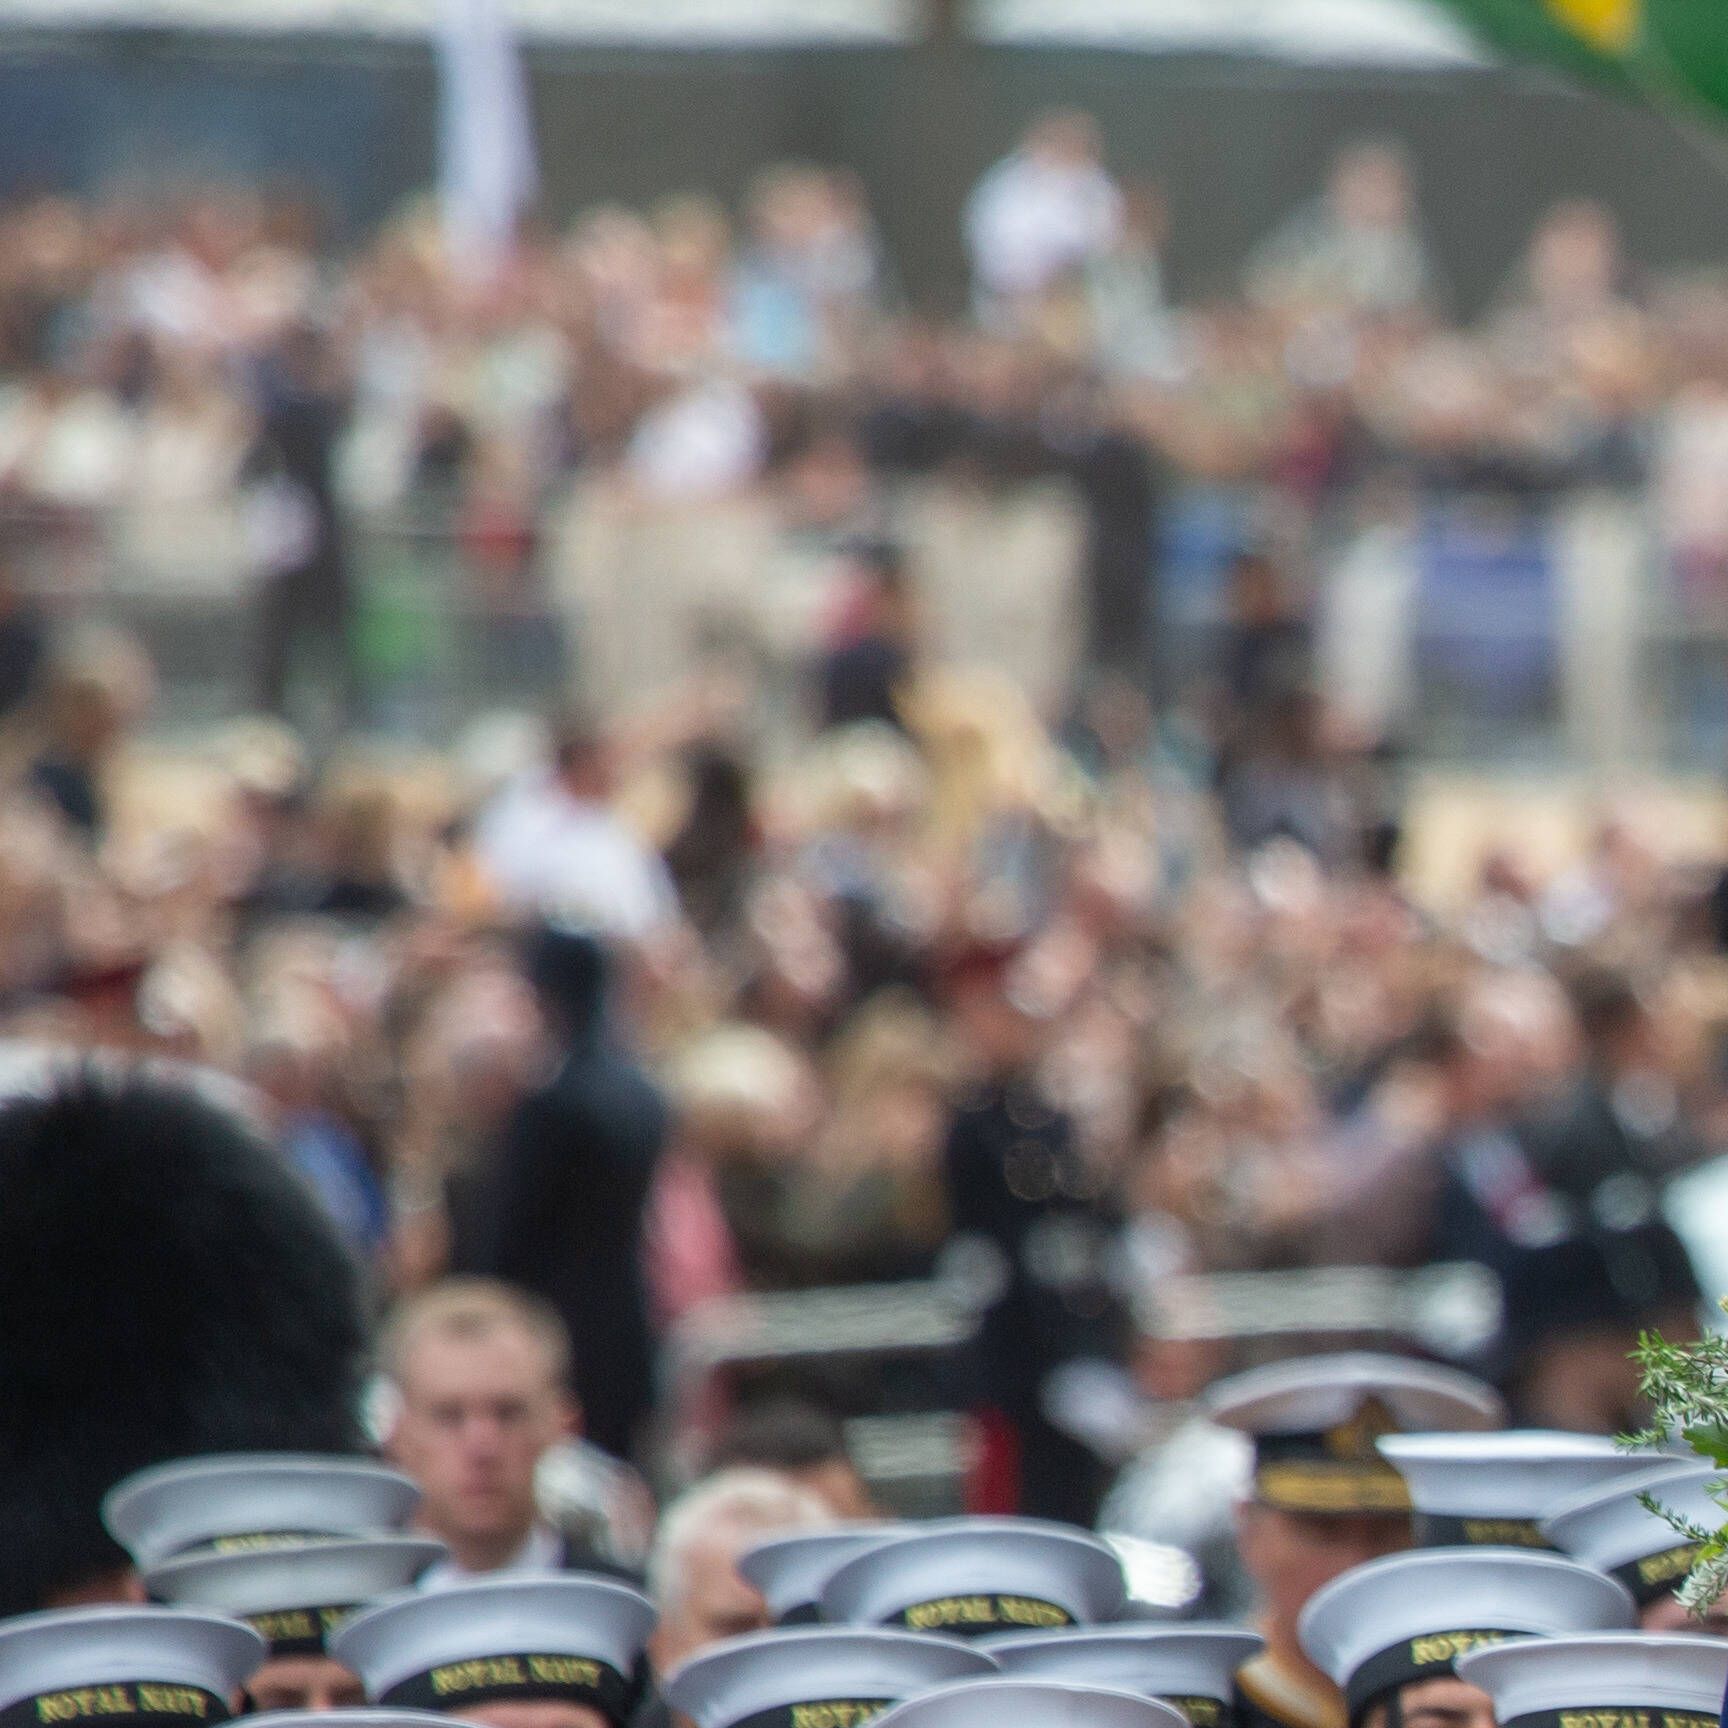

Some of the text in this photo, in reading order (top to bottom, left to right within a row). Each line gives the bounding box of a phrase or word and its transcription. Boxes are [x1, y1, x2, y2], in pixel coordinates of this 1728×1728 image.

[430, 1656, 528, 1696] ROYAL
[35, 1681, 209, 1724] ROYAL NAVY
